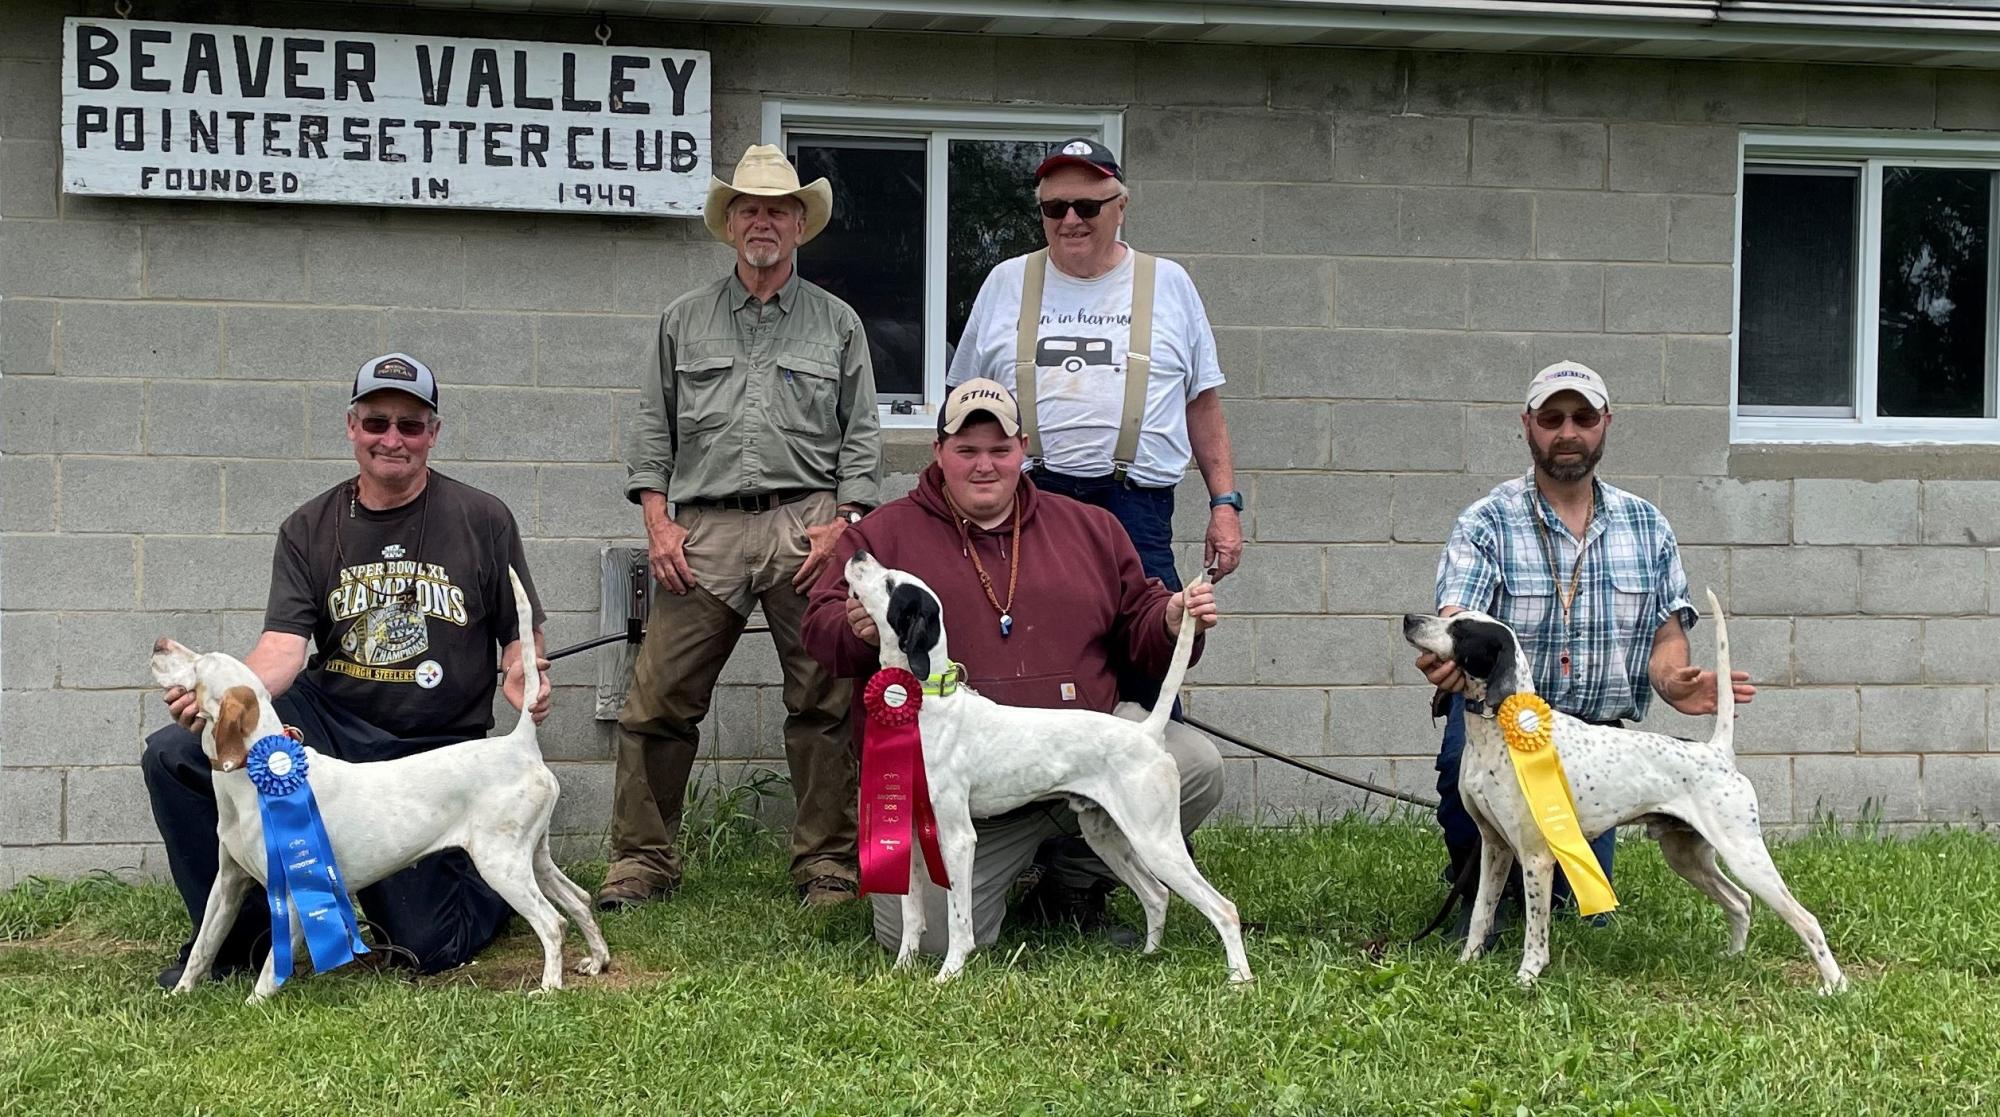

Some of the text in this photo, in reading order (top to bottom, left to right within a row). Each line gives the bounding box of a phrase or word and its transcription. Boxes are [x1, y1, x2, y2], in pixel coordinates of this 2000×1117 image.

[76, 25, 698, 117] BEAVER VALLEY
[76, 104, 699, 174] POINTER SETTER CLUB
[141, 166, 636, 208] FOUNDED IN 1949
[1058, 313, 1074, 324] in
[1078, 308, 1132, 326] harmo
[960, 389, 1004, 405] STIHL
[386, 560, 427, 576] BOWL
[426, 562, 450, 582] XL
[329, 577, 469, 626] CAMPONS
[375, 668, 415, 681] STEELERS
